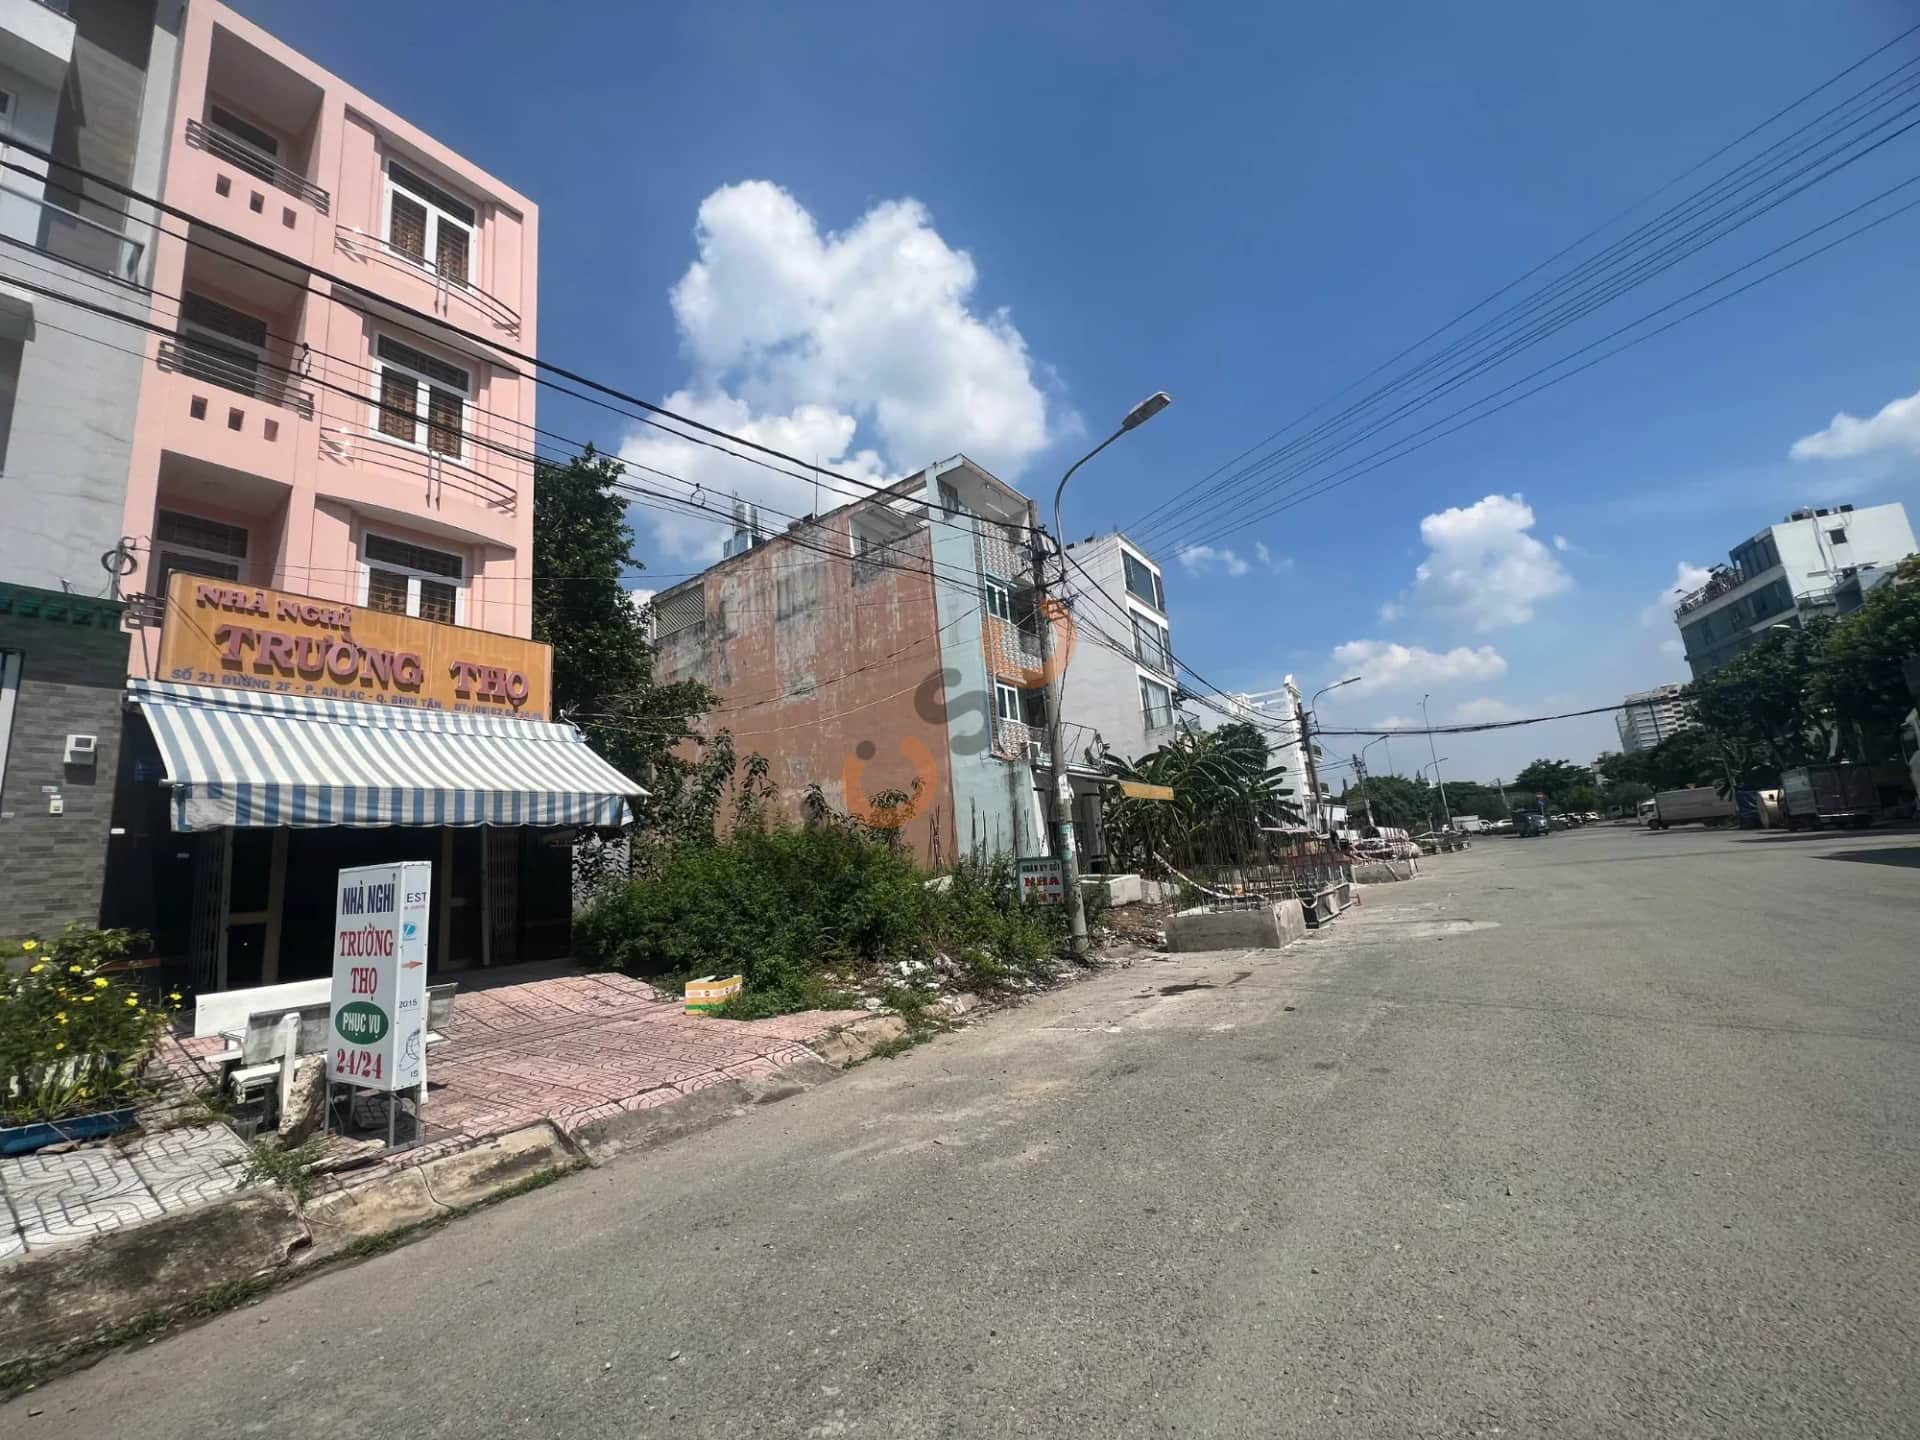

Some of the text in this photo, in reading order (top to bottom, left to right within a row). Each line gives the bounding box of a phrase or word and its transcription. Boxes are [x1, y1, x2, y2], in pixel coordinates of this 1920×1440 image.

[277, 599, 351, 629] NGHỈ
[172, 667, 193, 680] SỐ
[199, 672, 216, 683] 21
[276, 682, 291, 692] 2F
[322, 687, 337, 697] AN
[215, 624, 530, 711] TRƯỜNG THỌ
[342, 873, 396, 915] NHÀ NGHỈ
[340, 923, 393, 957] TRƯỜNG
[351, 967, 377, 1000] THỌ
[342, 1012, 380, 1038] PHỤC VỤ
[336, 1048, 382, 1079] 24/24
